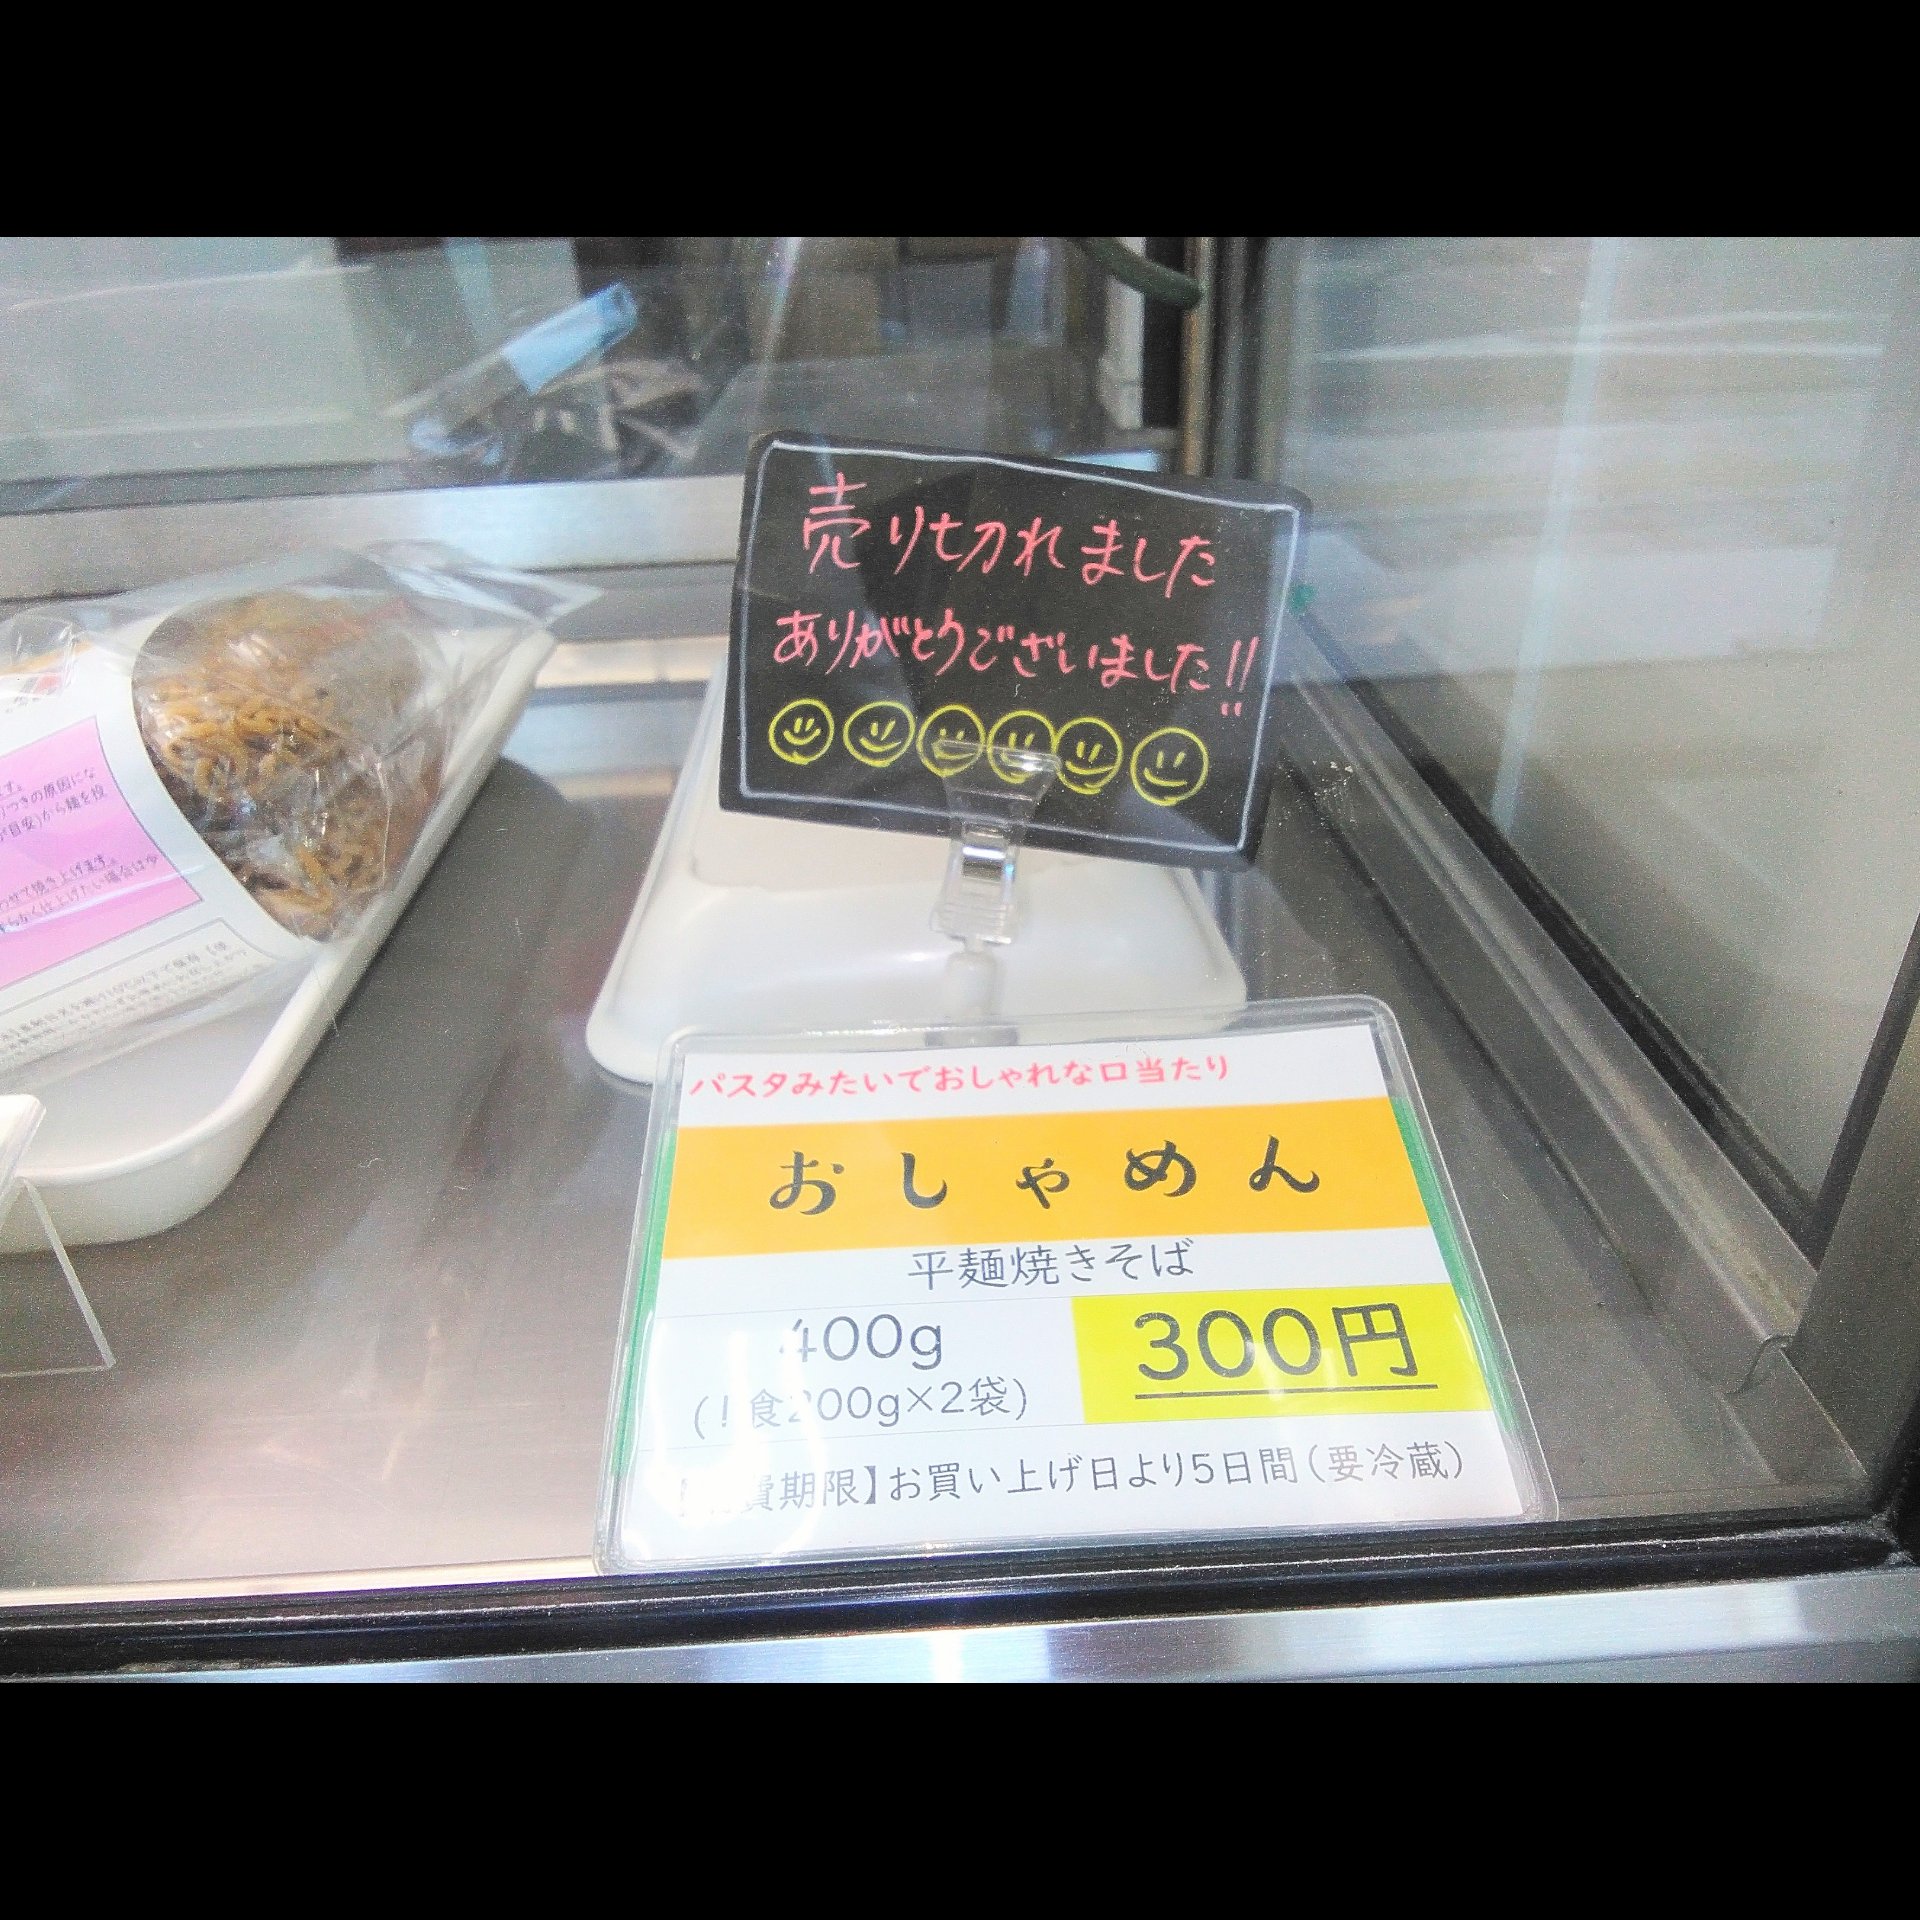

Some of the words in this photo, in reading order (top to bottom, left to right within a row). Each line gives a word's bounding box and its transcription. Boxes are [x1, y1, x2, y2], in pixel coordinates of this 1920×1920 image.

[803, 471, 1216, 598] 売り切れました
[691, 1054, 1228, 1099] パスタみたいでおしゃれな口当たり
[769, 1136, 1320, 1216] おしゃめん
[907, 1237, 1194, 1291] 平麺焼きそば
[1135, 1302, 1418, 1382] 300円
